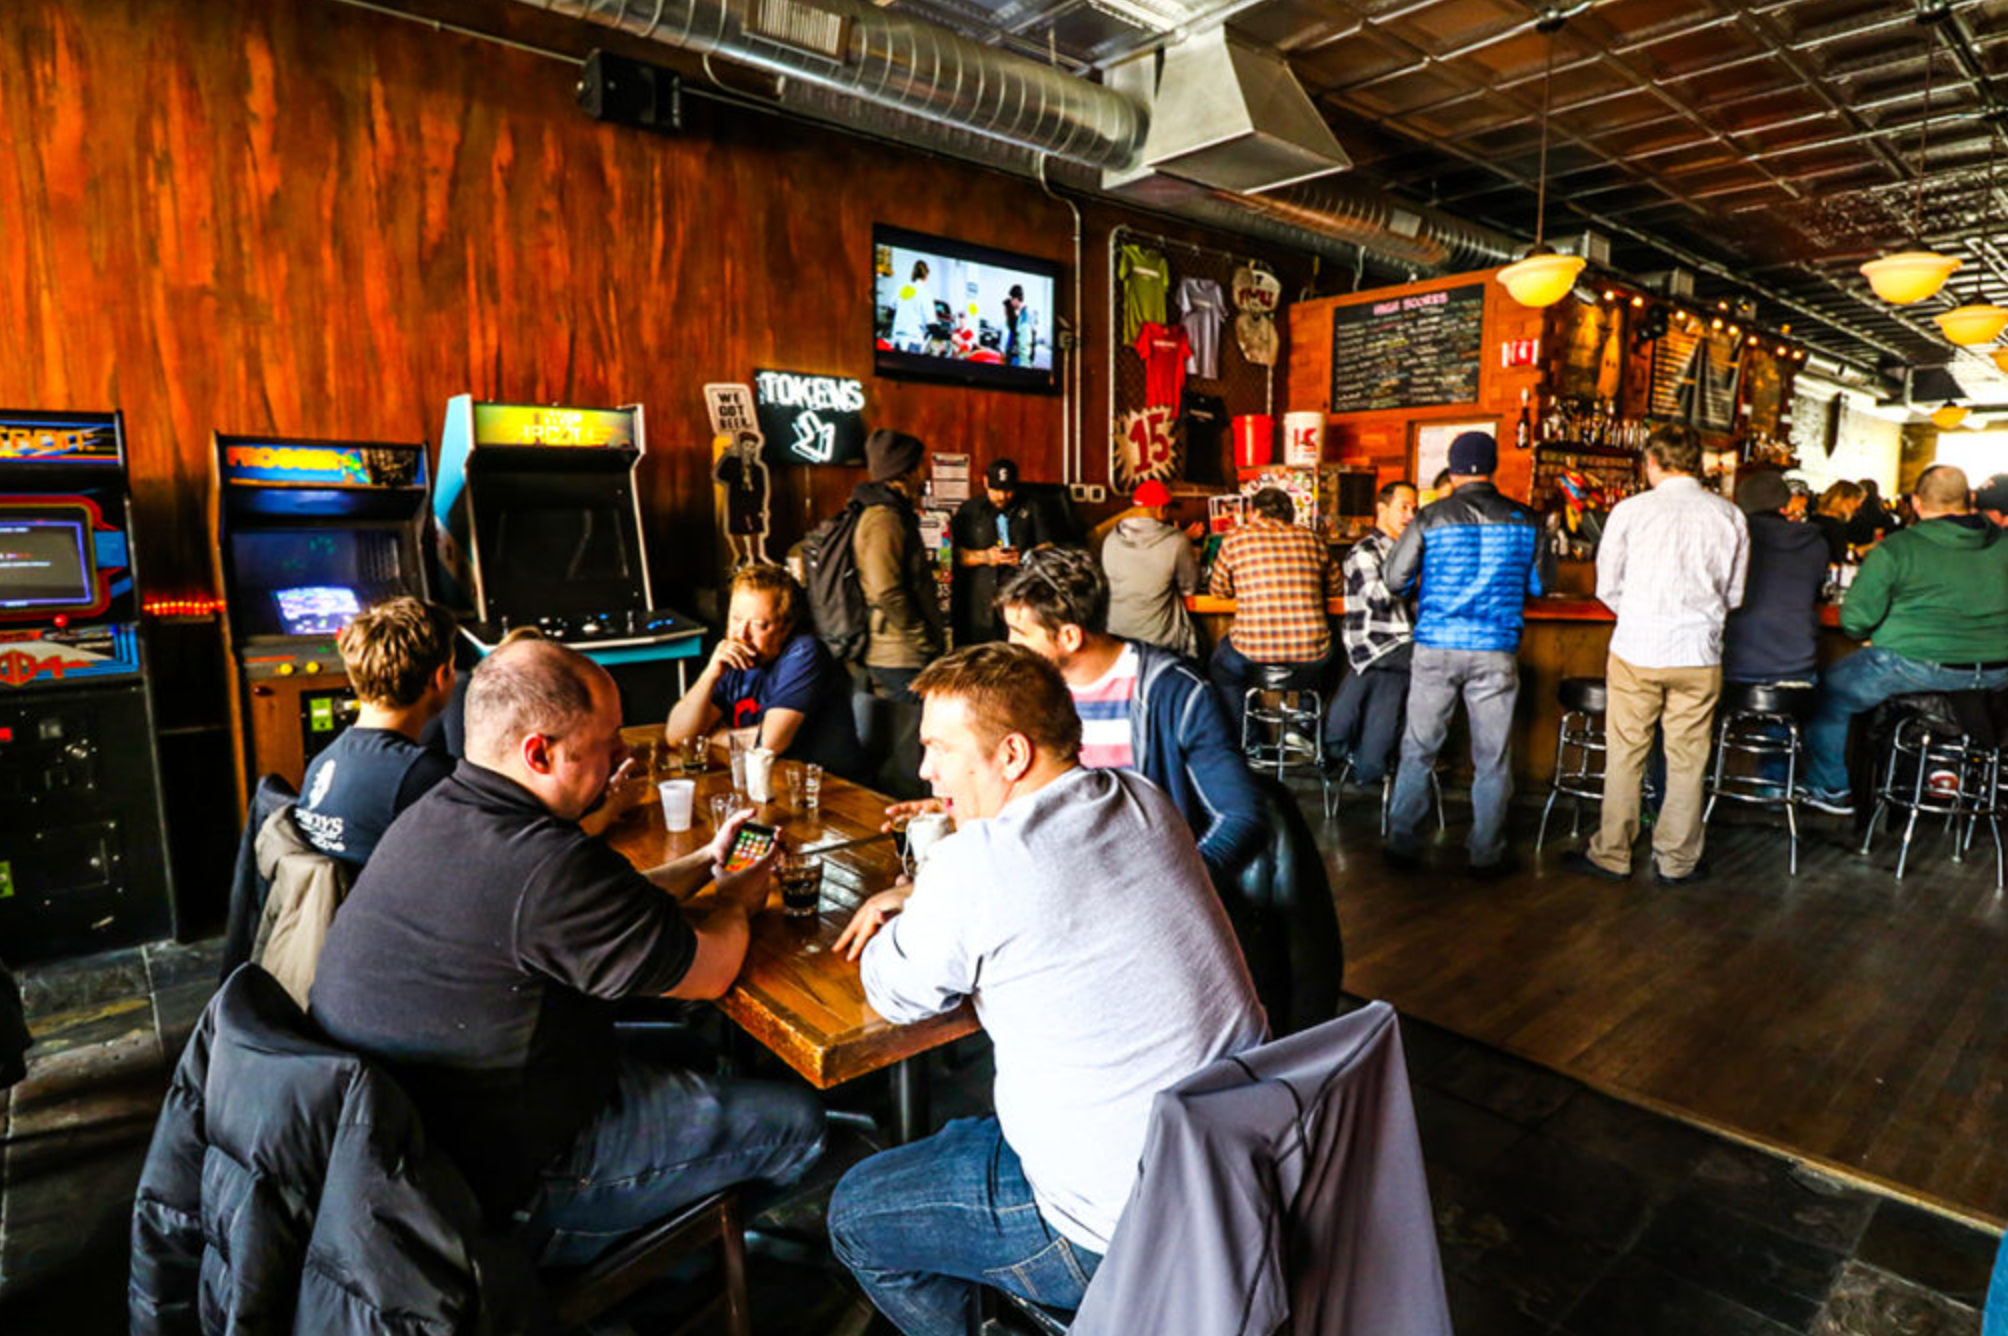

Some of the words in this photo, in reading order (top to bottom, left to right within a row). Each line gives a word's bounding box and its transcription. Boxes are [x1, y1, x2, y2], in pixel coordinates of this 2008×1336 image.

[717, 392, 739, 402] WE
[756, 371, 865, 412] TOKENS
[719, 404, 743, 416] GOT
[1129, 411, 1170, 474] 15
